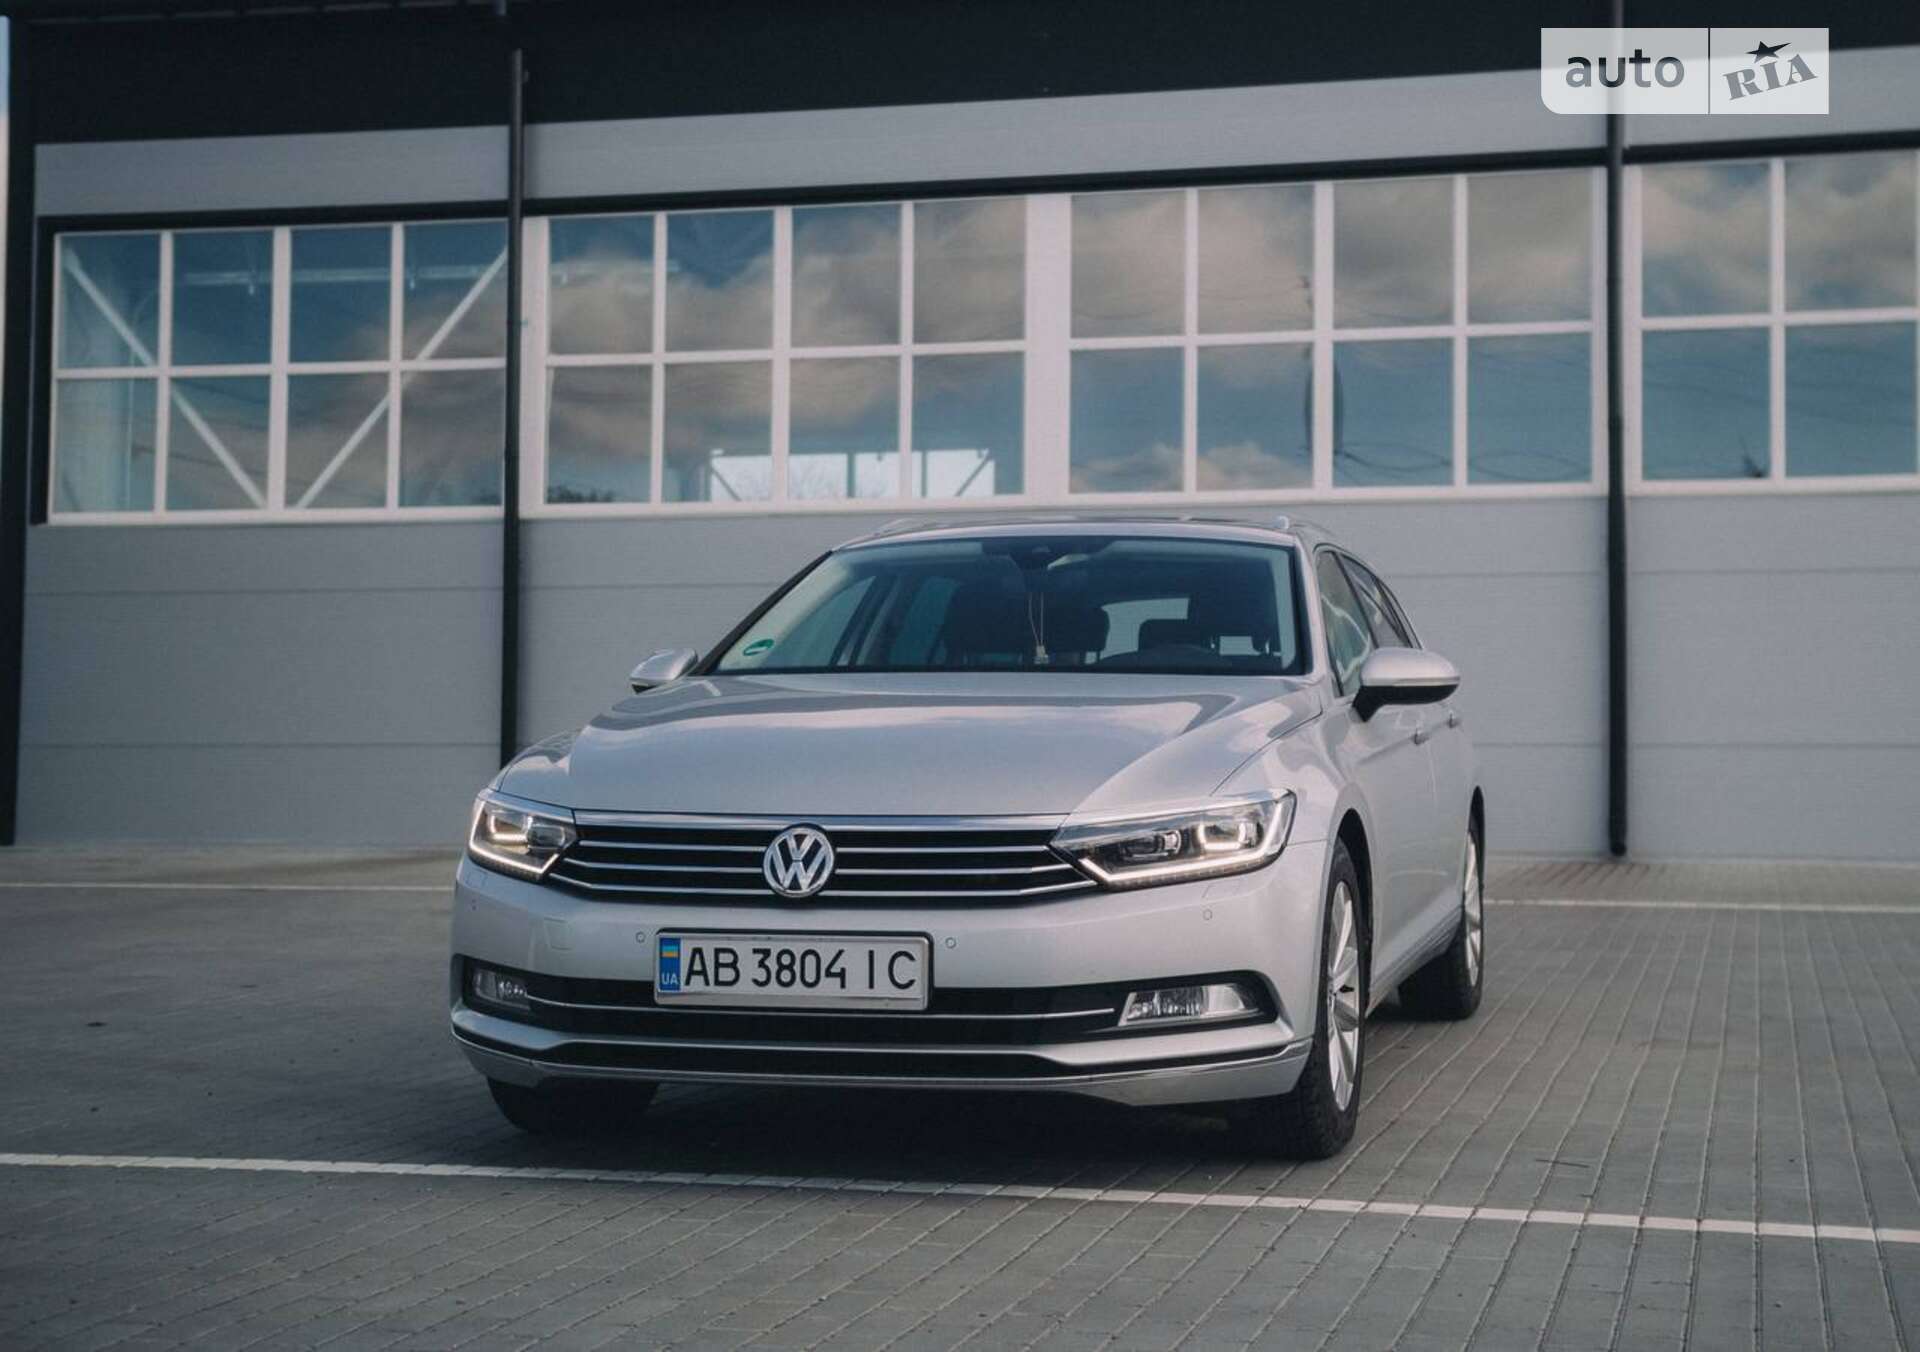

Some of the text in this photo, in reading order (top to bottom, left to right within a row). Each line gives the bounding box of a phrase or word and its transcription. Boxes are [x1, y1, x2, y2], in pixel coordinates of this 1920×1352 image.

[661, 972, 679, 985] UA
[684, 947, 917, 990] AB 3804 IC
